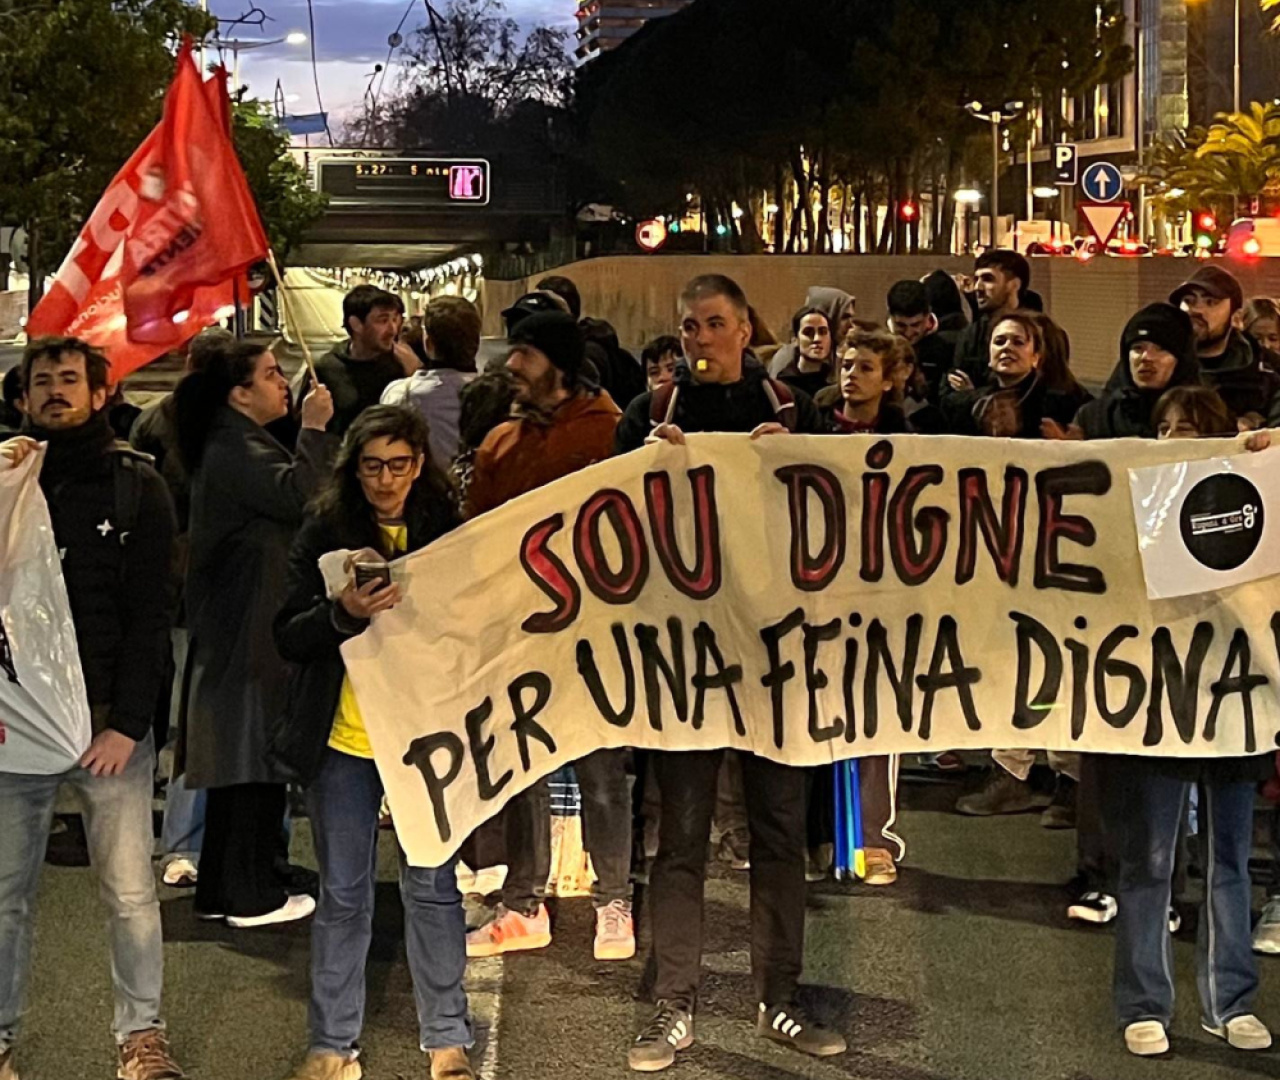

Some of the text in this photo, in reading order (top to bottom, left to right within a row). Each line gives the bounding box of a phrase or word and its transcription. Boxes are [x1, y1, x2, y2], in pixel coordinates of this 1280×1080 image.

[1056, 146, 1073, 169] P
[520, 465, 721, 633] SOU
[402, 670, 557, 843] PER
[575, 615, 746, 737] UNA
